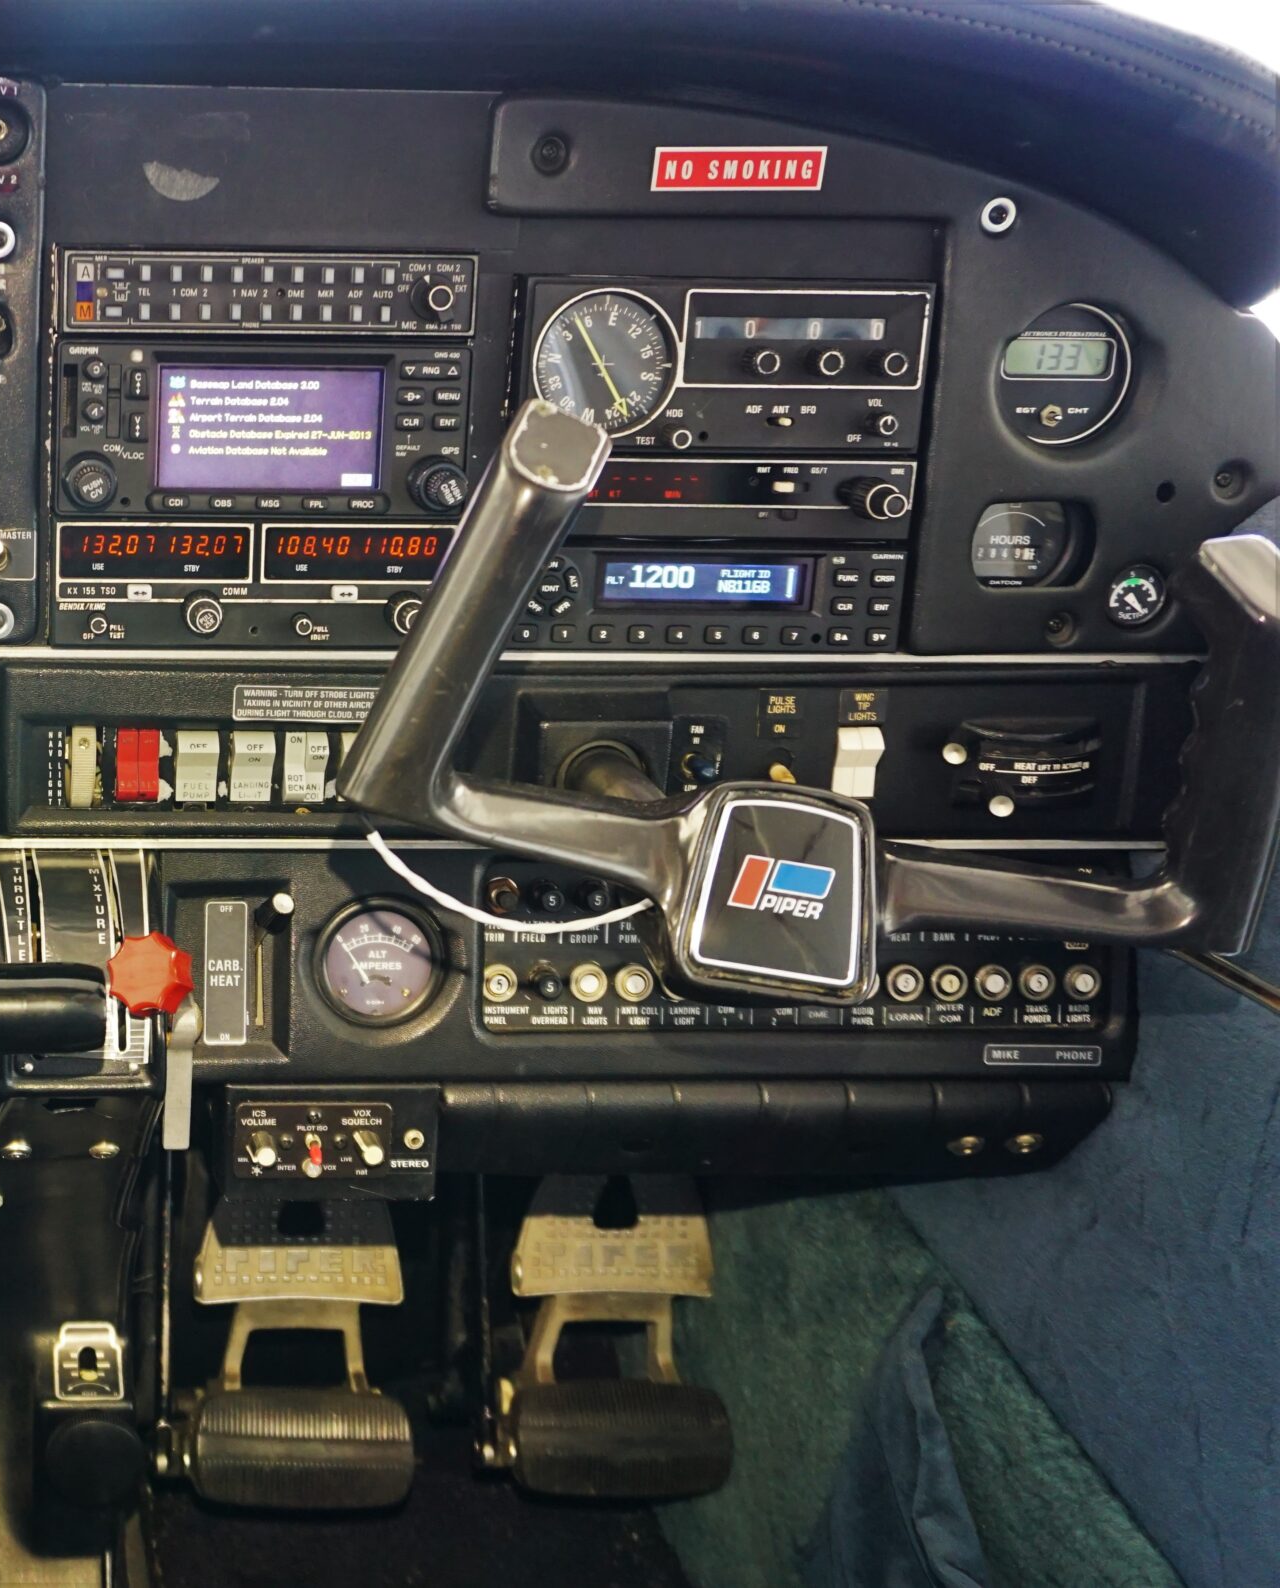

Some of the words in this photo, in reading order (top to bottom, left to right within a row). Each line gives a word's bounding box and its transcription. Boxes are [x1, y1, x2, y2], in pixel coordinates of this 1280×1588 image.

[665, 160, 693, 180] NO
[707, 160, 814, 180] SMOKING
[373, 291, 393, 300] AUTO
[1035, 344, 1082, 370] 133
[422, 366, 440, 374] RNG
[190, 379, 229, 390] Basemap
[231, 379, 253, 390] Land
[255, 380, 298, 390] Database
[190, 395, 222, 406] Terrain
[224, 396, 266, 406] Database
[437, 392, 460, 400] MENU
[746, 405, 763, 414] ADF
[772, 405, 790, 414] ANT
[189, 412, 222, 424] Airport
[224, 413, 256, 423] Terrain
[258, 413, 301, 423] Database
[439, 418, 456, 426] ENT
[229, 429, 272, 440] Database
[274, 429, 308, 441] Expired
[311, 430, 372, 440] 27-JUN-2013
[635, 436, 655, 445] TEST
[188, 446, 224, 456] Aviation
[225, 446, 269, 456] Database
[289, 446, 327, 456] Available
[352, 499, 374, 509] PROC
[0, 531, 32, 540] MASTER
[989, 535, 1031, 546] HOURS
[81, 535, 156, 557] 132.07
[169, 535, 243, 557] 132.07
[277, 536, 351, 557] 108.40
[363, 536, 438, 558] 110.80
[872, 553, 904, 561] GARMIN
[628, 564, 696, 589] 1200
[720, 569, 754, 579] FLIGHT
[837, 574, 859, 582] FUNC
[223, 587, 248, 596] COMM
[717, 580, 771, 594] N8116B
[244, 689, 277, 698] WARNING
[284, 690, 302, 699] TURN
[305, 691, 318, 699] OFF
[320, 691, 347, 700] STROBE
[349, 692, 375, 700] LIGHTS
[854, 693, 874, 702] WING
[243, 699, 270, 708] TAXIING
[282, 700, 312, 709] VICINITY
[324, 702, 347, 710] OTHER
[770, 696, 796, 706] PULSE
[237, 709, 264, 717] DURING
[266, 709, 291, 718] FLIGHT
[293, 710, 326, 719] THROUGH
[768, 705, 796, 715] LIGHTS
[848, 712, 877, 721] LIGHTS
[690, 725, 704, 734] FAN
[89, 868, 107, 945] MIXTURE
[220, 905, 234, 913] OFF
[758, 894, 824, 920] PIPER
[13, 867, 27, 962] THROTTLE
[484, 932, 505, 943] TRIM
[570, 934, 599, 944] GROUP
[368, 950, 387, 959] ALT
[208, 959, 244, 972] CARB.
[352, 961, 402, 971] AMPERES
[210, 976, 241, 987] HEAT
[484, 1006, 529, 1015] INSTRUMENT
[543, 1006, 568, 1015] LIGHTS
[670, 1007, 701, 1016] LANDING
[484, 1017, 507, 1025] PANEL
[531, 1017, 568, 1026] OVERHEAD
[582, 1017, 608, 1026] LIGHTS
[889, 1012, 923, 1022] LORAN
[992, 1050, 1019, 1060] MIKE
[1056, 1051, 1093, 1061] PHONE
[241, 1118, 277, 1126] VOLUME
[341, 1118, 382, 1127] SQUELCH
[277, 1164, 296, 1172] INTER
[390, 1159, 429, 1169] STEREO
